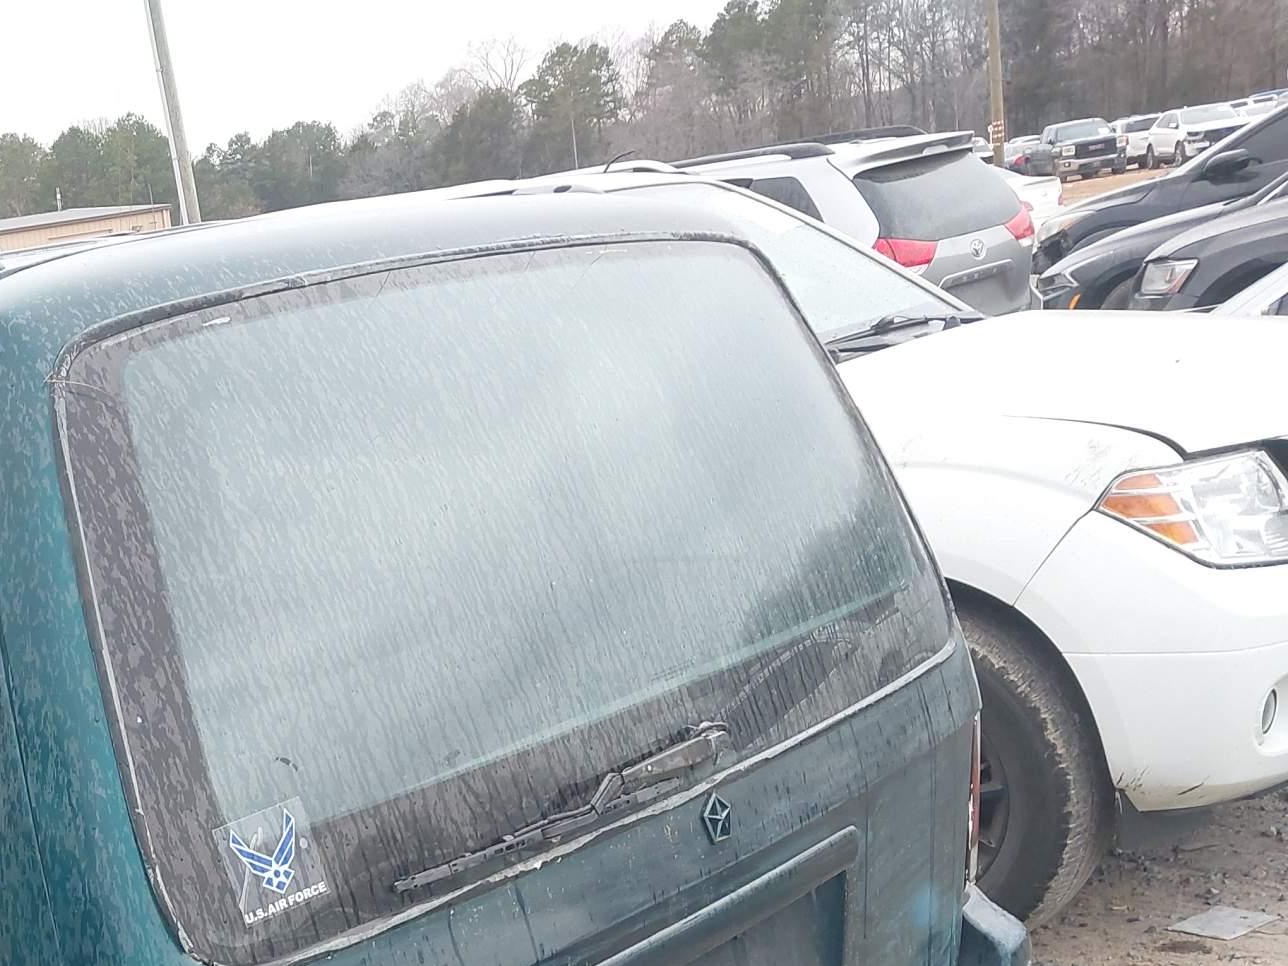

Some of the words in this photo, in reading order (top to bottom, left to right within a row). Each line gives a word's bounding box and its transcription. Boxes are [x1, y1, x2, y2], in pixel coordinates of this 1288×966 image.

[244, 908, 267, 924] U.S.
[267, 898, 288, 916] AIR
[288, 881, 327, 906] FORCE
